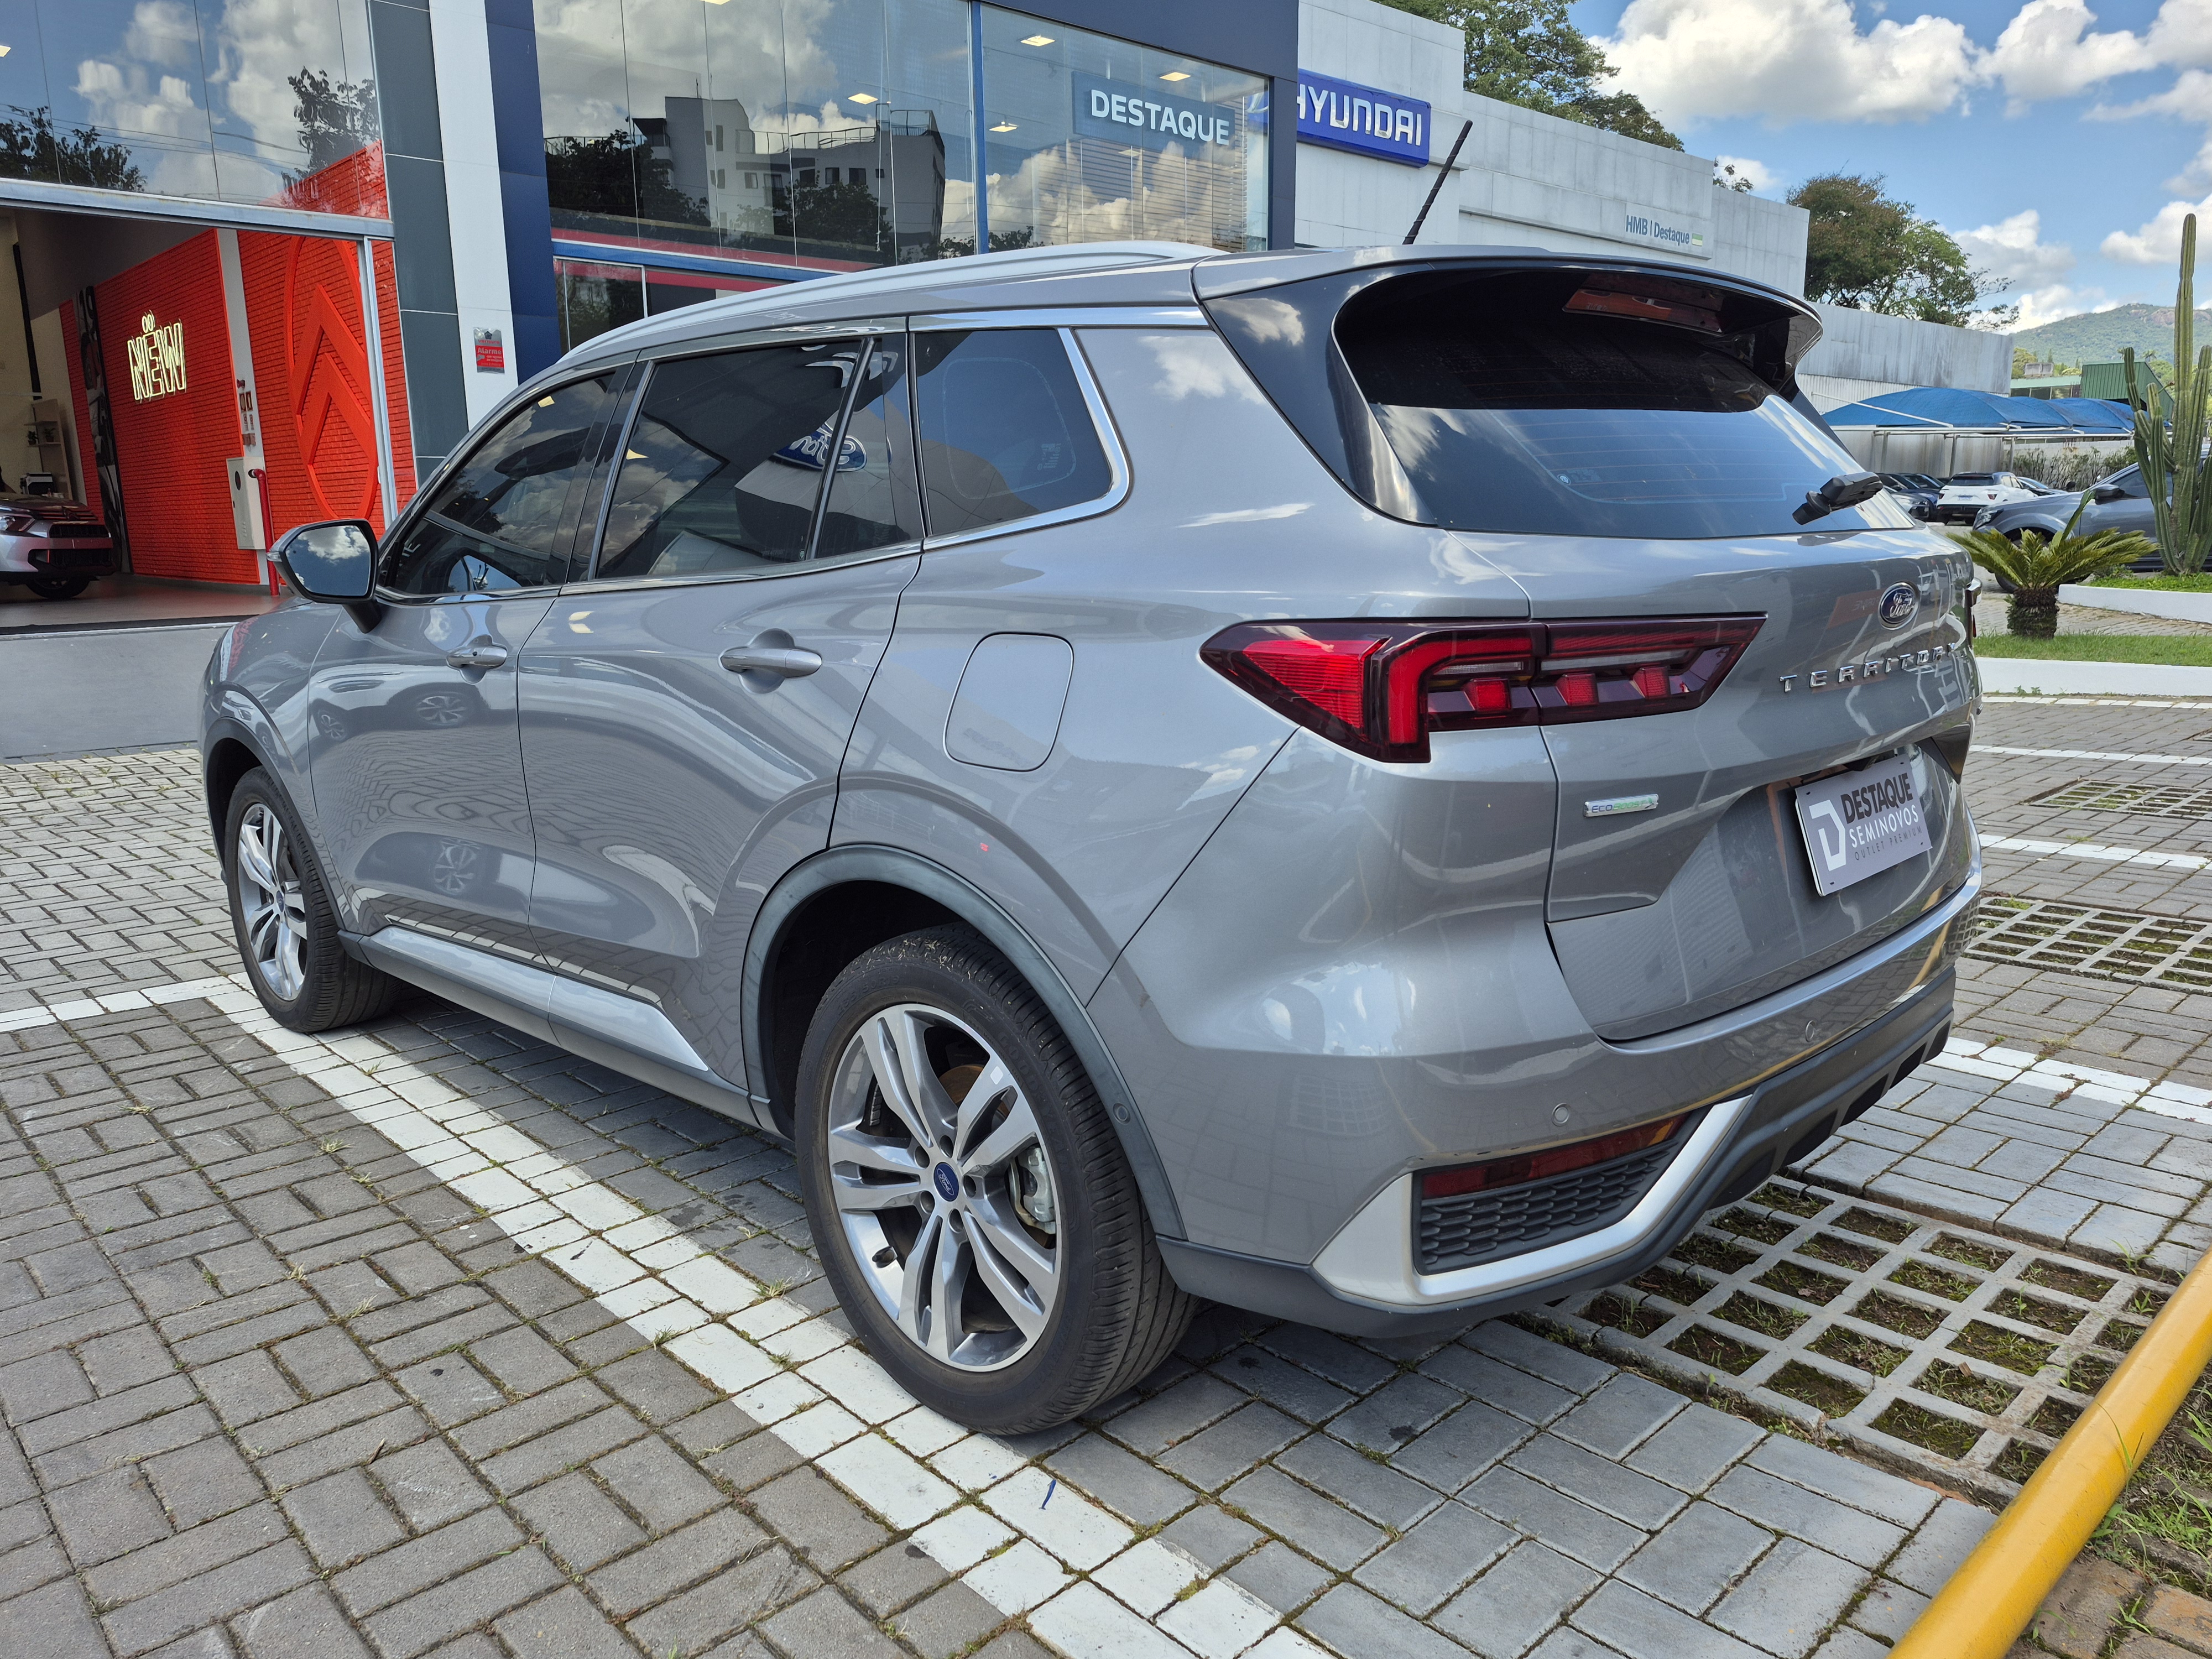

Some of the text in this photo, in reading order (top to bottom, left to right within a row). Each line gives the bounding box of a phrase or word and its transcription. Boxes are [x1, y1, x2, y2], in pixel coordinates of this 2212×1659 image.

[1091, 89, 1229, 145] DESTAQUE
[1626, 215, 1648, 236] HMB
[1654, 222, 1690, 246] Destaque
[477, 347, 502, 355] Alarme
[1779, 643, 1955, 692] TERRITORY
[1840, 773, 1913, 824] DESTAQUE
[1849, 805, 1919, 848] SEMINOVOS
[1854, 826, 1922, 860] OUTLET PREMIUM
